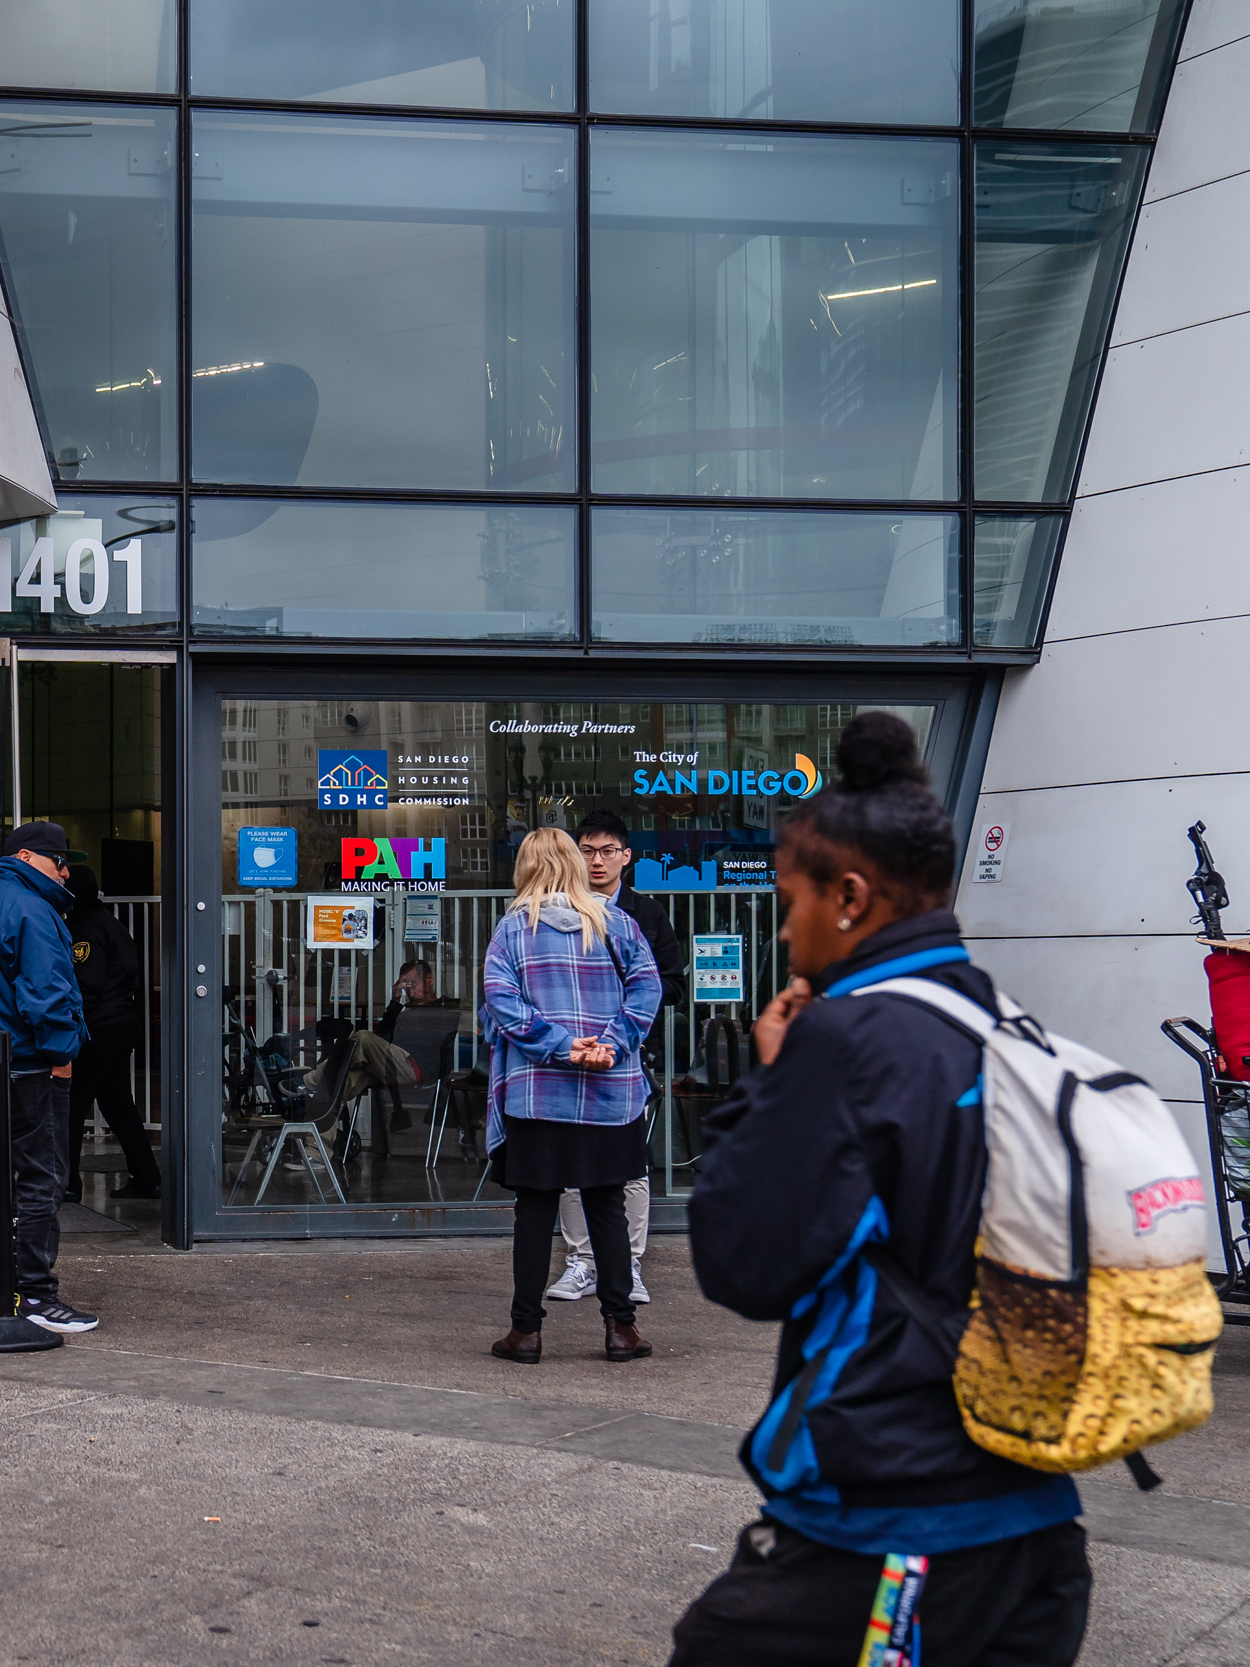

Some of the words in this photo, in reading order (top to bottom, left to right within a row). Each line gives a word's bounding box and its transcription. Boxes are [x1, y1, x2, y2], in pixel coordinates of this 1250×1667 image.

[489, 719, 579, 738] Collaborating
[581, 720, 636, 734] Partners
[397, 755, 422, 763] SAN
[428, 755, 469, 763] DIEGO
[633, 751, 656, 762] The
[659, 751, 684, 765] City
[686, 751, 699, 765] of
[398, 776, 469, 785] HOUSING
[633, 769, 698, 795] SAN
[708, 769, 808, 796] DIEGO
[323, 793, 384, 806] SDHC
[398, 797, 470, 806] COMMISSION
[341, 837, 446, 879] PATH
[723, 870, 767, 881] Regional
[341, 881, 390, 892] MAKING
[394, 881, 405, 892] IT
[408, 881, 446, 892] HOME
[739, 881, 756, 890] the
